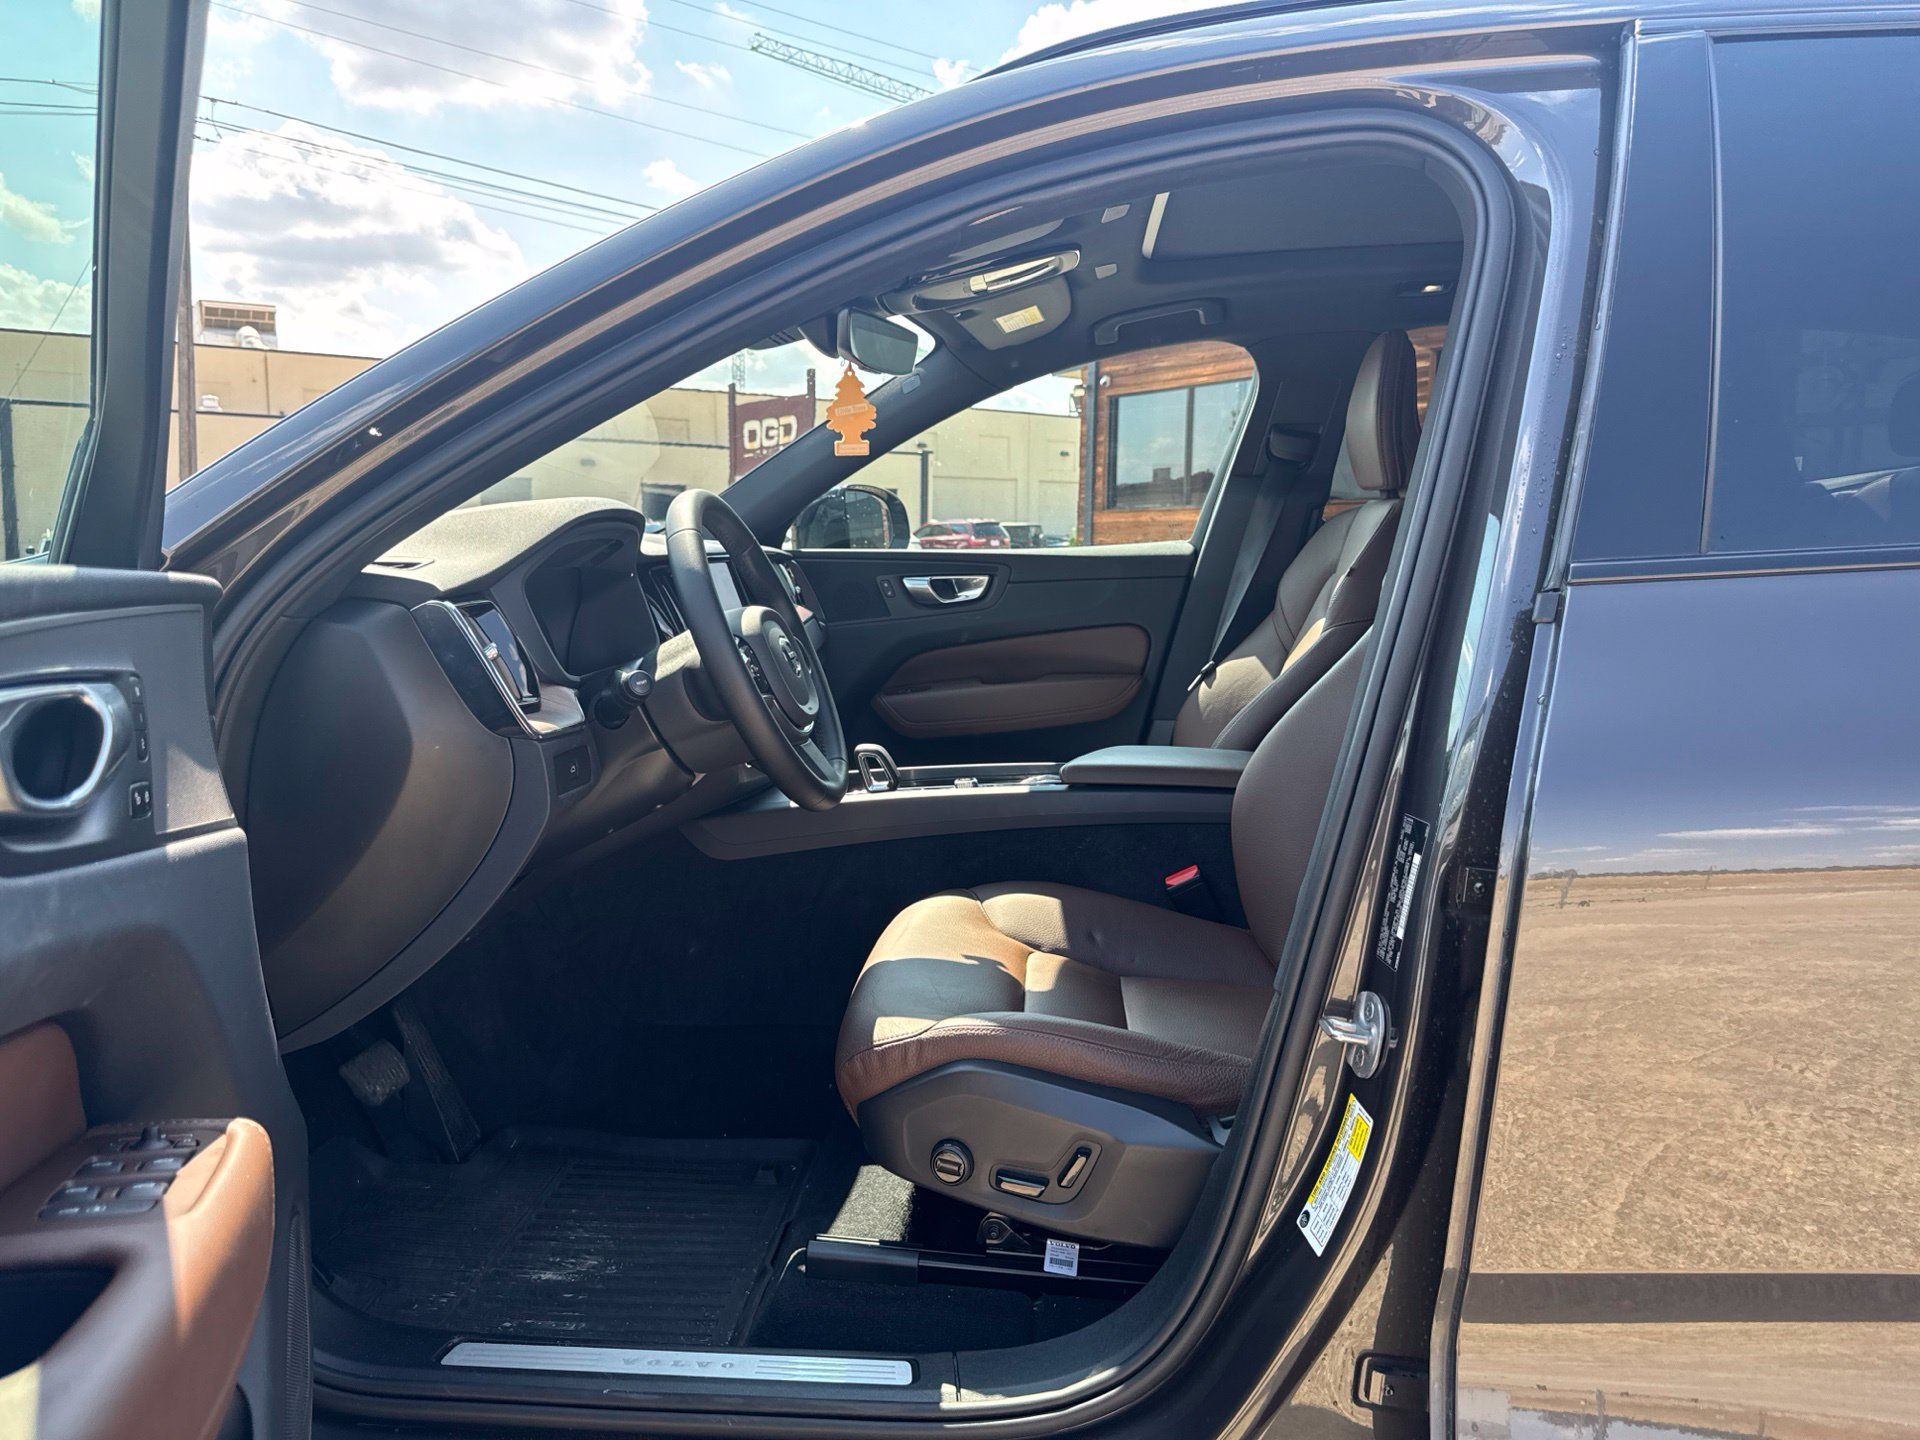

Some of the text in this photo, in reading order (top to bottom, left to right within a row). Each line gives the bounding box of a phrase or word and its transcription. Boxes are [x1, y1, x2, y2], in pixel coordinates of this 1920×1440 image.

[743, 415, 798, 449] OGD
[1049, 1240, 1076, 1249] VOLVO
[621, 1357, 735, 1369] VOLVO
